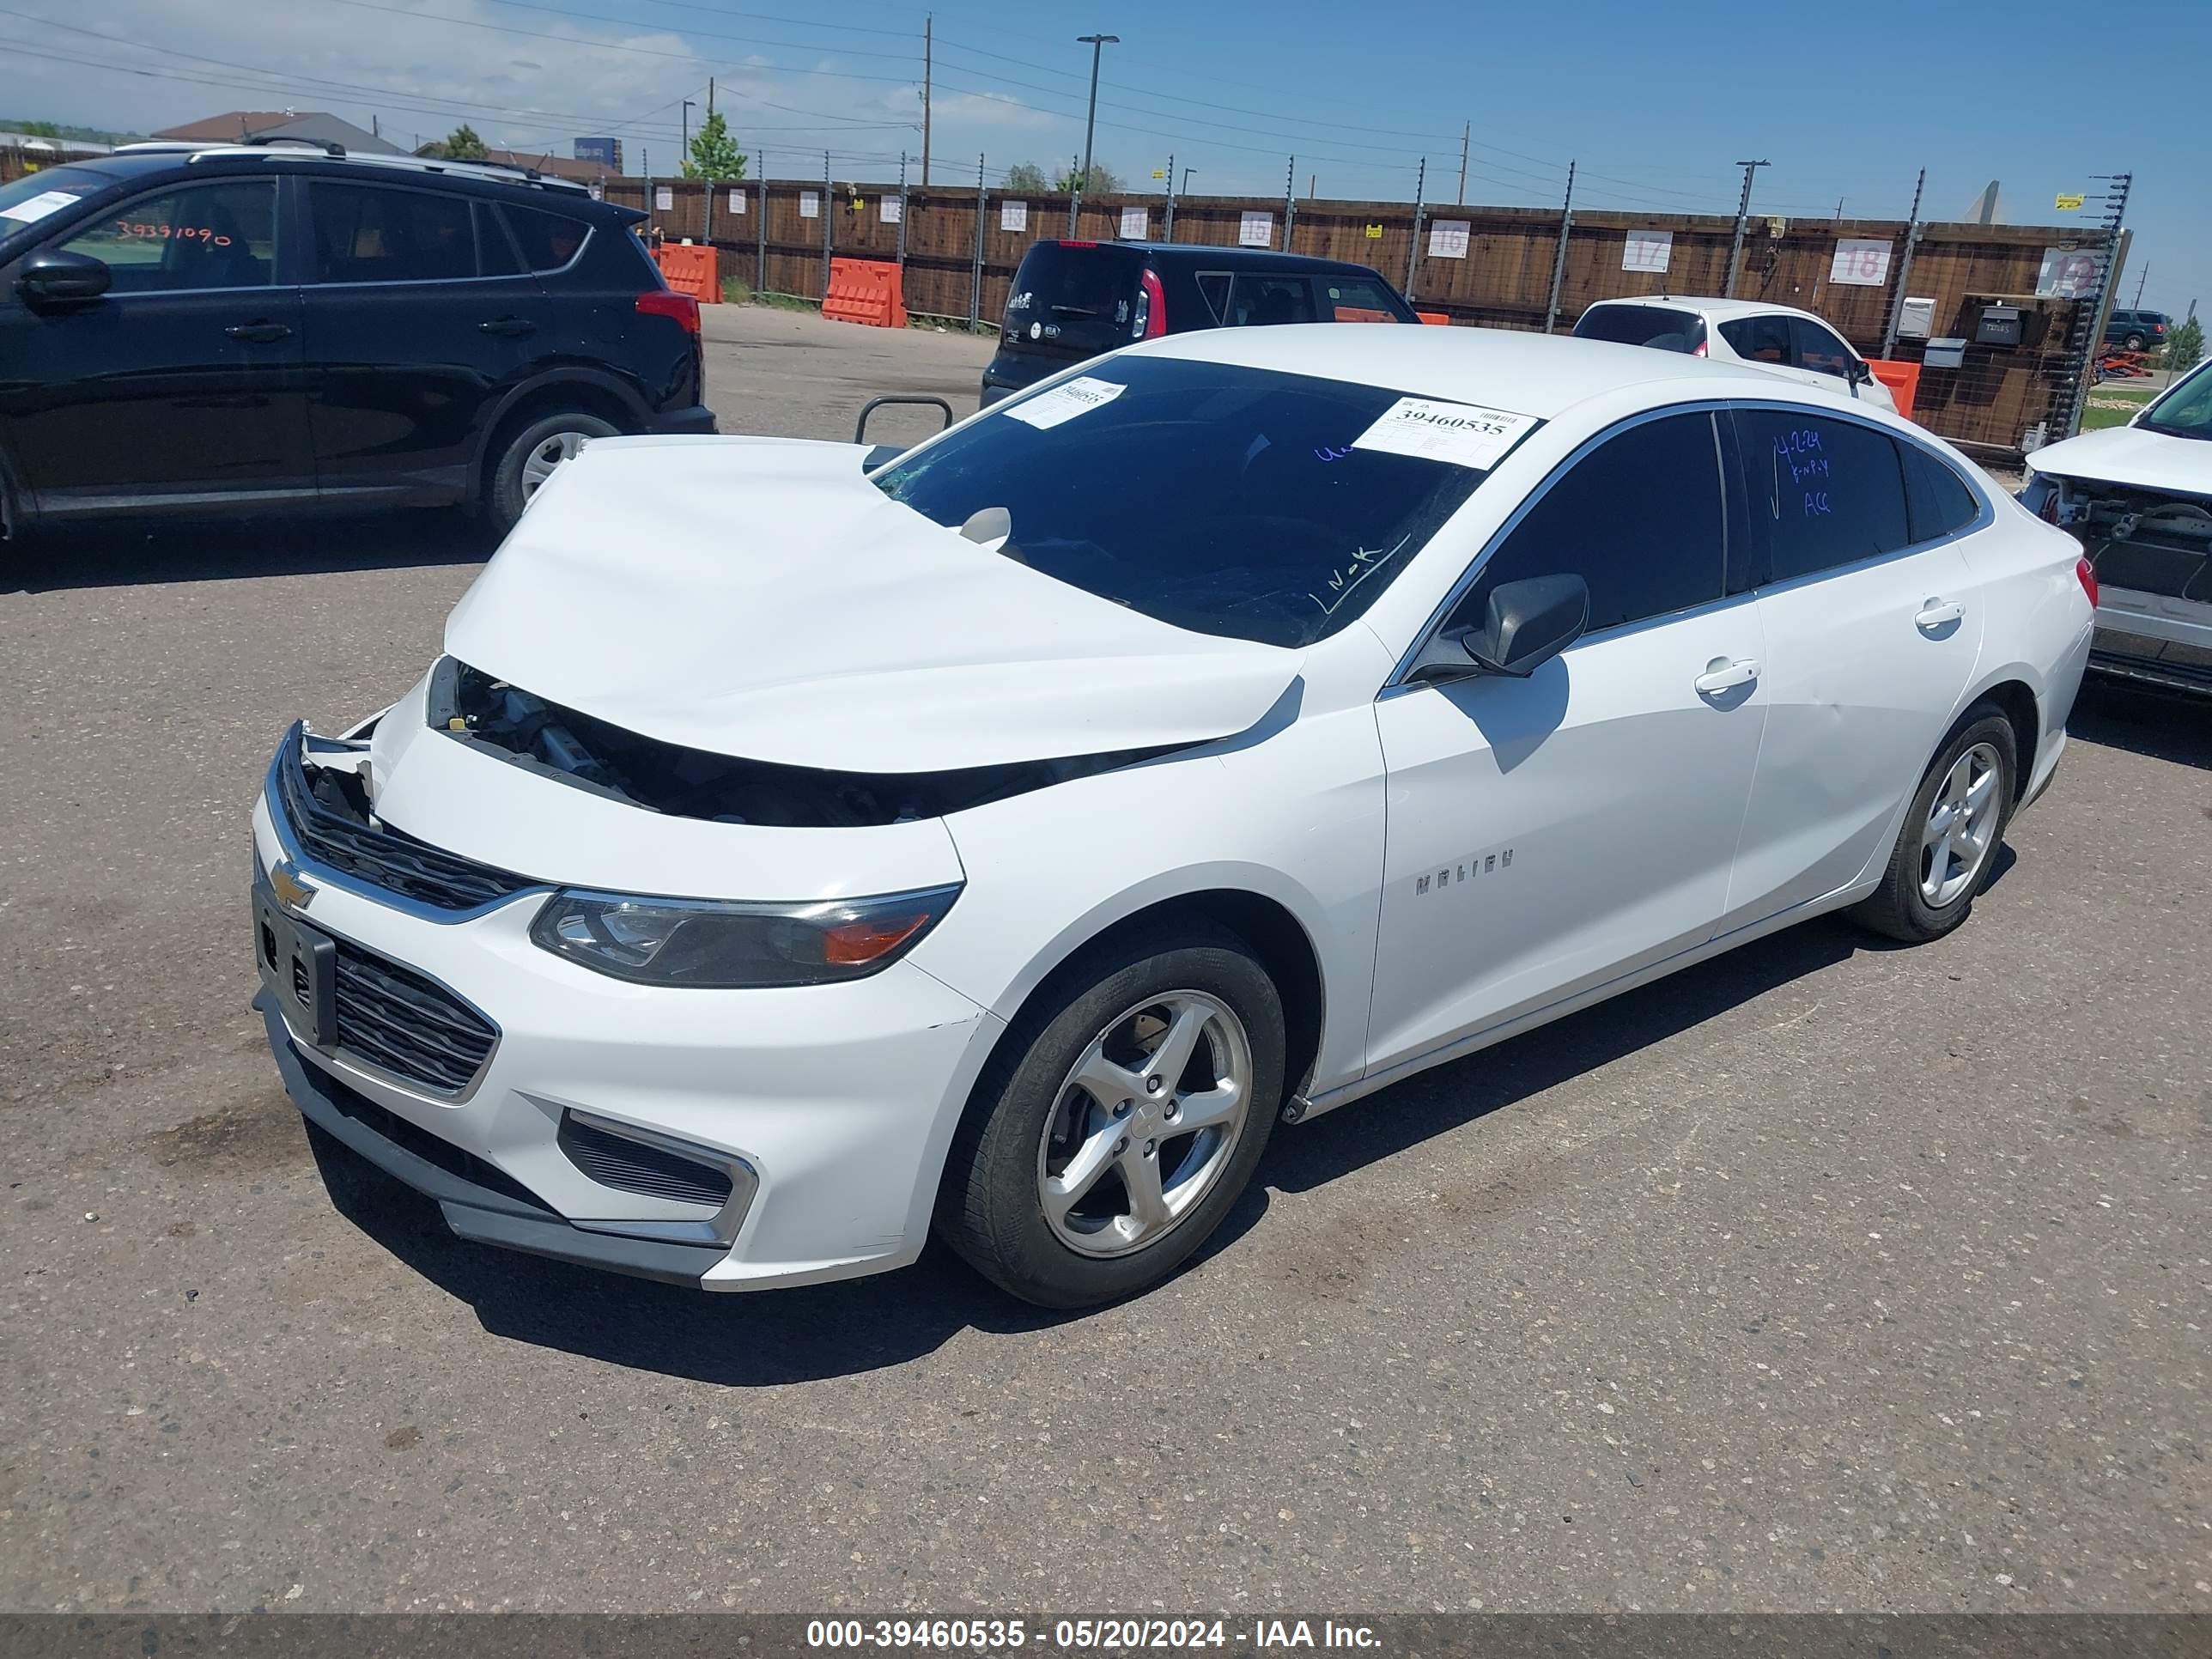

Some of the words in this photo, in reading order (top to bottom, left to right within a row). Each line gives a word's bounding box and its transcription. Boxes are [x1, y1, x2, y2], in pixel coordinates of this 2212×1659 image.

[1635, 237, 1664, 265] 17
[1846, 246, 1882, 277] 18
[1395, 410, 1507, 435] 39460535
[1415, 848, 1514, 896] MALIBU
